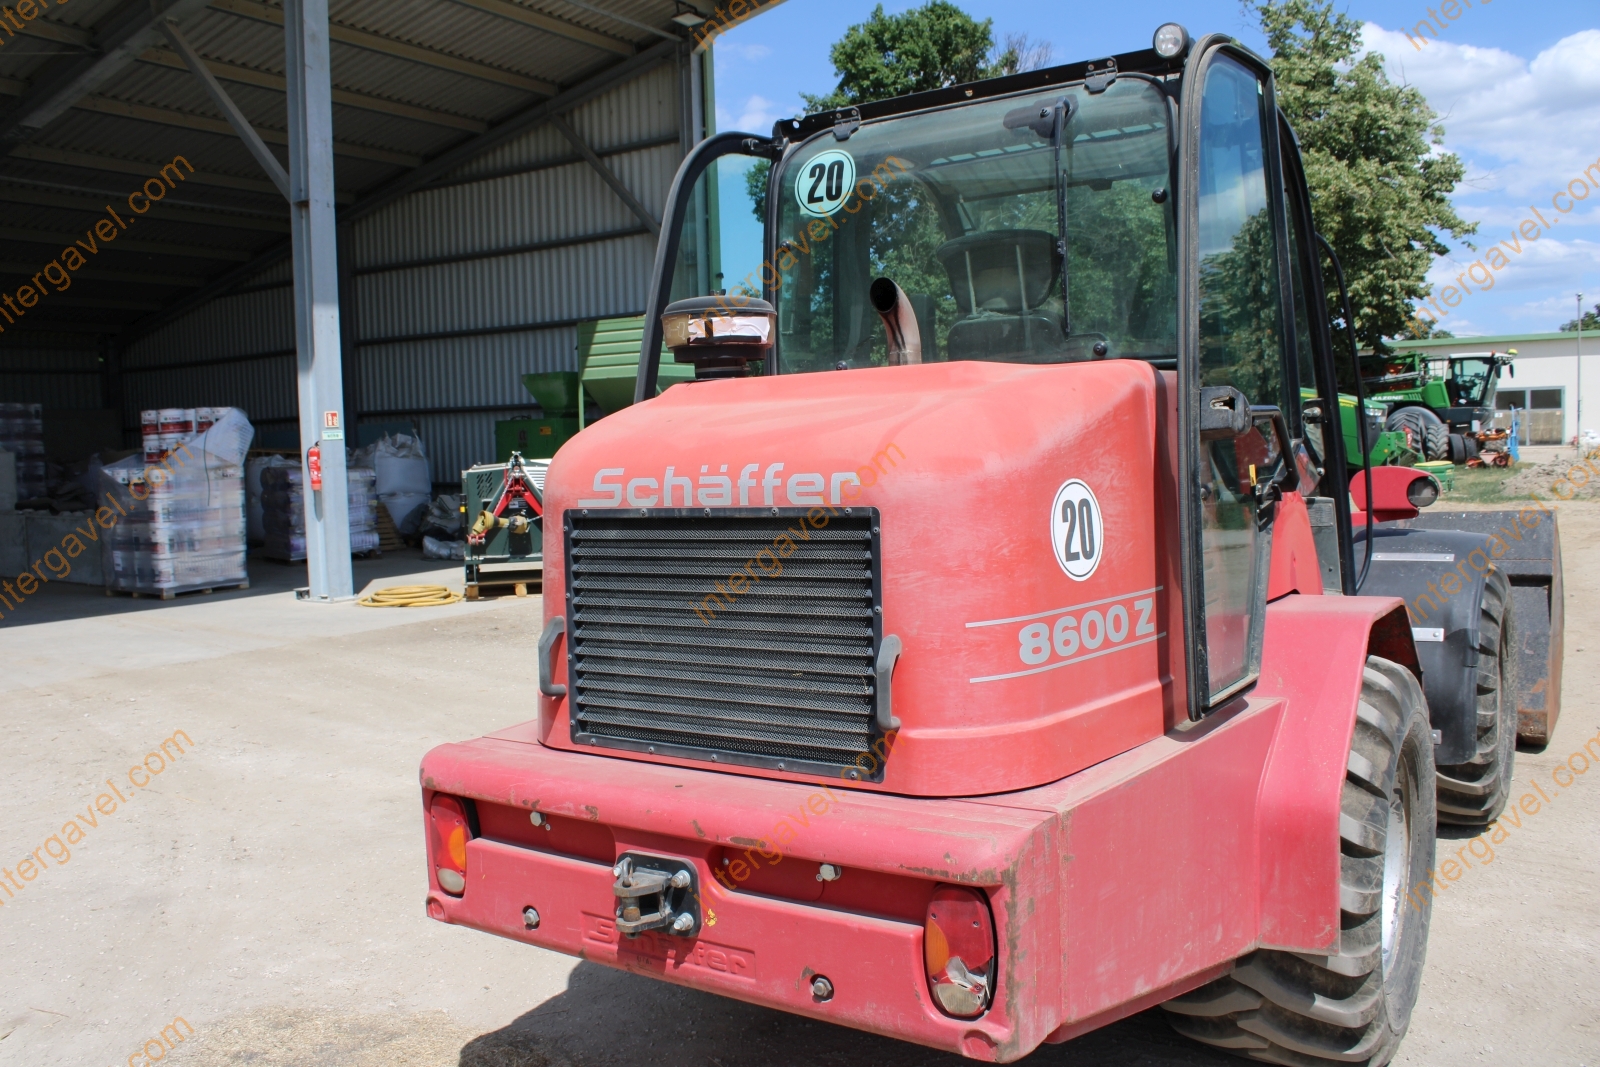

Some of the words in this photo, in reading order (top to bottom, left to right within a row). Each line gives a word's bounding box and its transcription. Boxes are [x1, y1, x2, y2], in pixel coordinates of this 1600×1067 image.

[807, 160, 845, 205] 20
[577, 462, 861, 508] Schäffer
[1061, 498, 1095, 562] 20
